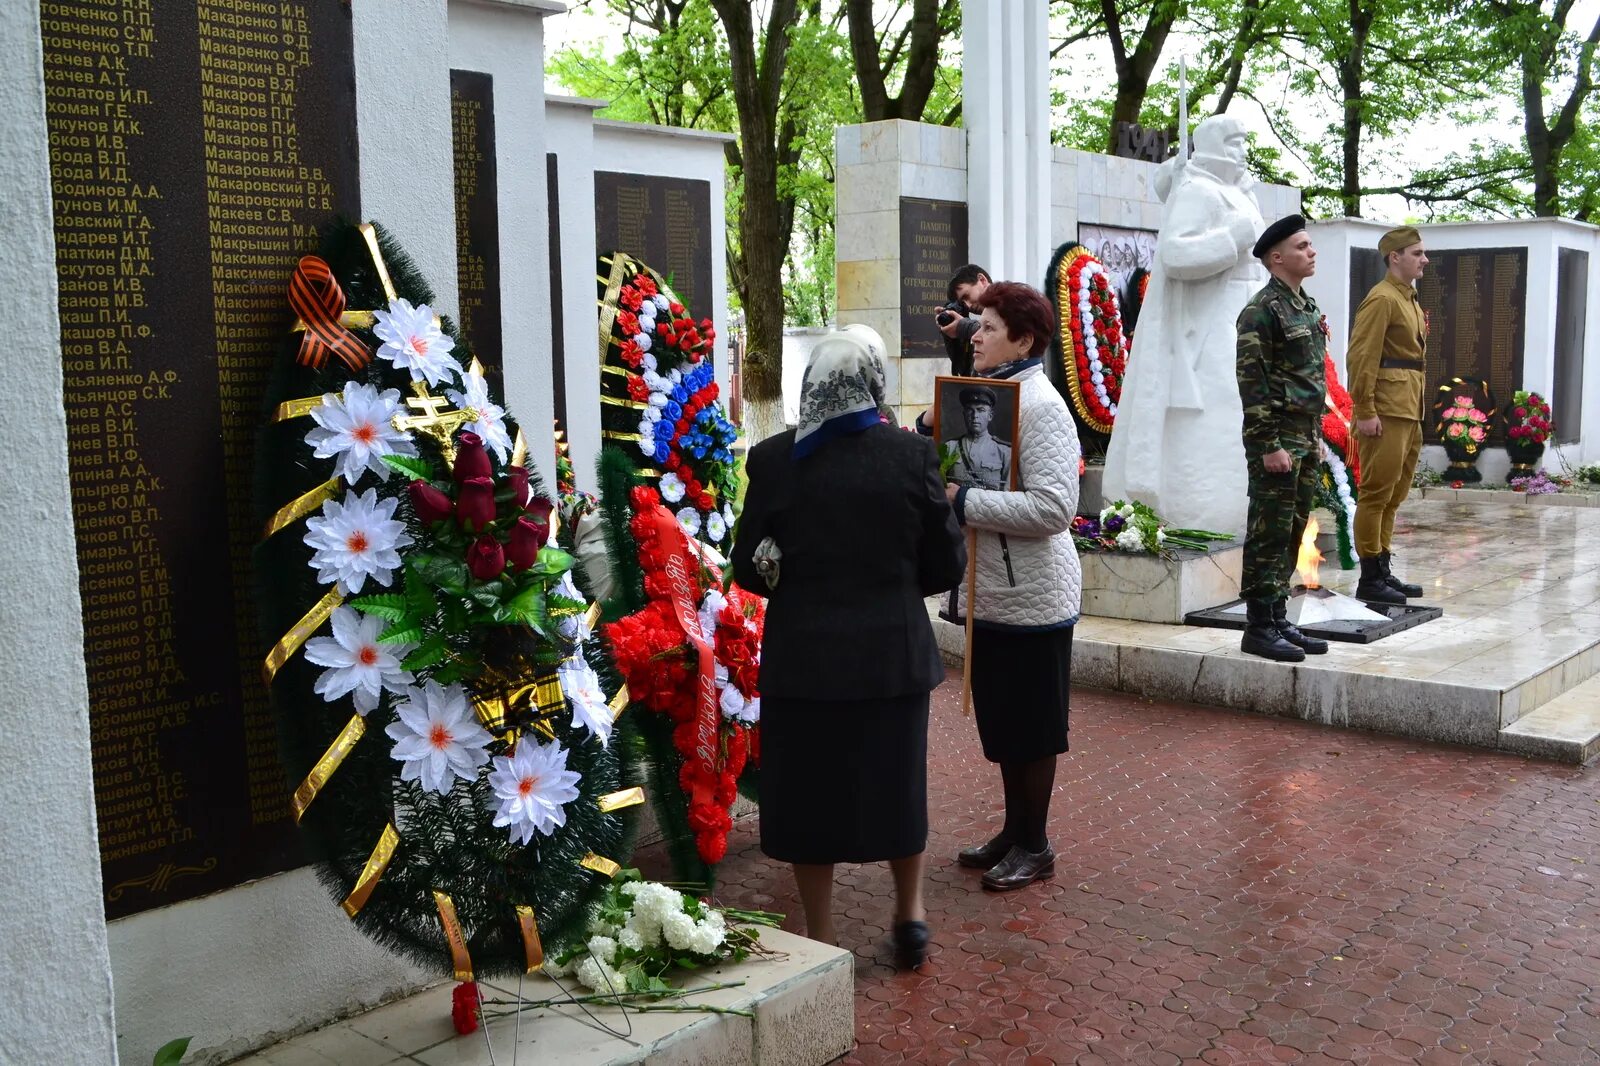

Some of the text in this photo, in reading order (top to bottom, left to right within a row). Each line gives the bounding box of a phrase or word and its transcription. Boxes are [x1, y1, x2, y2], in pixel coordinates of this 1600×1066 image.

[123, 10, 155, 27] П.П.
[281, 3, 309, 19] И.Н.
[197, 7, 311, 33] Макаренко М.В.
[124, 26, 158, 42] С.М.
[199, 22, 312, 50] Макаренко Ф.Д.
[124, 42, 154, 58] Т.П.
[200, 38, 313, 66] Макаренко Ф.Д.
[99, 55, 129, 71] А.К.
[201, 53, 300, 77] Макаркин В.Г.
[100, 71, 129, 87] А.Т.
[202, 69, 298, 92] Макаров В.Я.
[121, 88, 153, 105] И.П.
[203, 84, 297, 107] Макаров Г.М.
[105, 103, 132, 119] Г.Е.
[204, 100, 295, 121] Макаров П.Г.
[114, 120, 144, 136] И.К.
[204, 115, 300, 136] Макаров П.И.
[96, 134, 129, 150] И.В.
[205, 130, 301, 150] Макаров П.С.
[98, 151, 131, 166] В.Л.
[206, 144, 302, 165] Макаров Я.Я.
[99, 167, 132, 183] И.Д.
[206, 160, 327, 181] Макаровкий В.В.
[132, 184, 163, 199] А.А.
[207, 175, 335, 196] Макаровский В.И.
[108, 200, 142, 214] И.М.
[208, 190, 333, 210] Макаровский С.В.
[209, 206, 295, 222] Макеев С.В.
[128, 215, 156, 230] Г.А.
[920, 221, 951, 232] ПАМЯТИ
[123, 231, 152, 245] И.Т.
[210, 236, 290, 252] Макрышин
[915, 234, 957, 247] ПОГИБШИХ
[120, 246, 155, 262] Д.М.
[929, 250, 949, 260] ГОДЫ
[121, 262, 155, 276] М.А.
[212, 265, 292, 280] Максименк
[917, 262, 951, 272] ВЕЛИКОЙ
[114, 278, 146, 292] И.В.
[213, 280, 288, 294] Максимен
[114, 294, 149, 308] М.В.
[100, 309, 133, 323] П.И.
[907, 305, 935, 315] ПОСВЯ
[121, 325, 156, 338] П.Ф.
[61, 341, 132, 356] ков В.А.
[62, 356, 133, 372] ков И.П.
[63, 370, 182, 388] кьяненко А.Ф.
[64, 386, 172, 403] кьянцов С.К.
[65, 403, 137, 419] нев А.С.
[67, 418, 138, 435] нев В.И.
[68, 434, 139, 451] нев В.П.
[69, 449, 142, 466] нев Н.Ф.
[70, 463, 151, 482] пина А.А.
[71, 477, 165, 498] пырев А.К.
[73, 494, 151, 517] рье Ю.М.
[75, 507, 162, 530] ценко В.П.
[77, 524, 154, 544] чков П.С.
